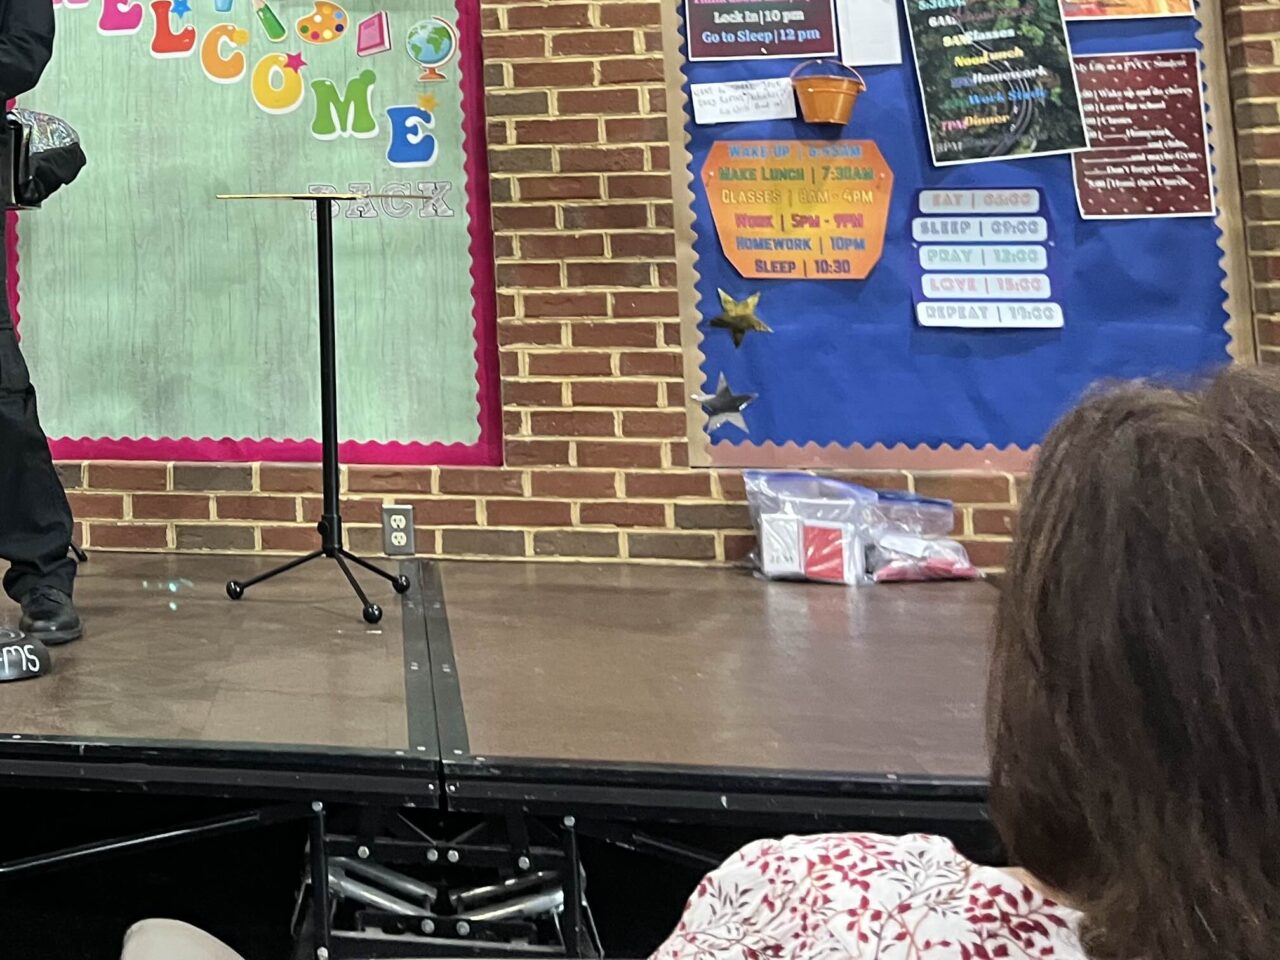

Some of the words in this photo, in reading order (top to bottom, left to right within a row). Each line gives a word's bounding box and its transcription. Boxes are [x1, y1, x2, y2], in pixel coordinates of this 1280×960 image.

[713, 11, 743, 24] Lock
[782, 9, 804, 23] pm
[702, 31, 719, 43] Go
[722, 31, 735, 41] to
[798, 28, 820, 41] pm
[972, 65, 1048, 84] Homework
[965, 115, 1010, 128] Dinner
[729, 146, 767, 158] WAKE
[774, 146, 790, 158] UP
[720, 168, 757, 181] MAKE
[761, 167, 804, 181] LUNCH
[822, 166, 873, 181] 7:30AM
[722, 189, 781, 204] CLASSES
[843, 191, 873, 203] 4PM
[932, 194, 963, 207] EAT
[791, 214, 820, 228] 5PM
[920, 221, 971, 235] SLEEP
[736, 236, 812, 251] HOMEWORK
[830, 237, 866, 250] 10PM
[927, 249, 973, 263] PRAY
[755, 259, 796, 273] SLEEP
[814, 260, 851, 274] 10:30
[930, 277, 977, 292] LOVE
[925, 306, 988, 320] REPEAT
